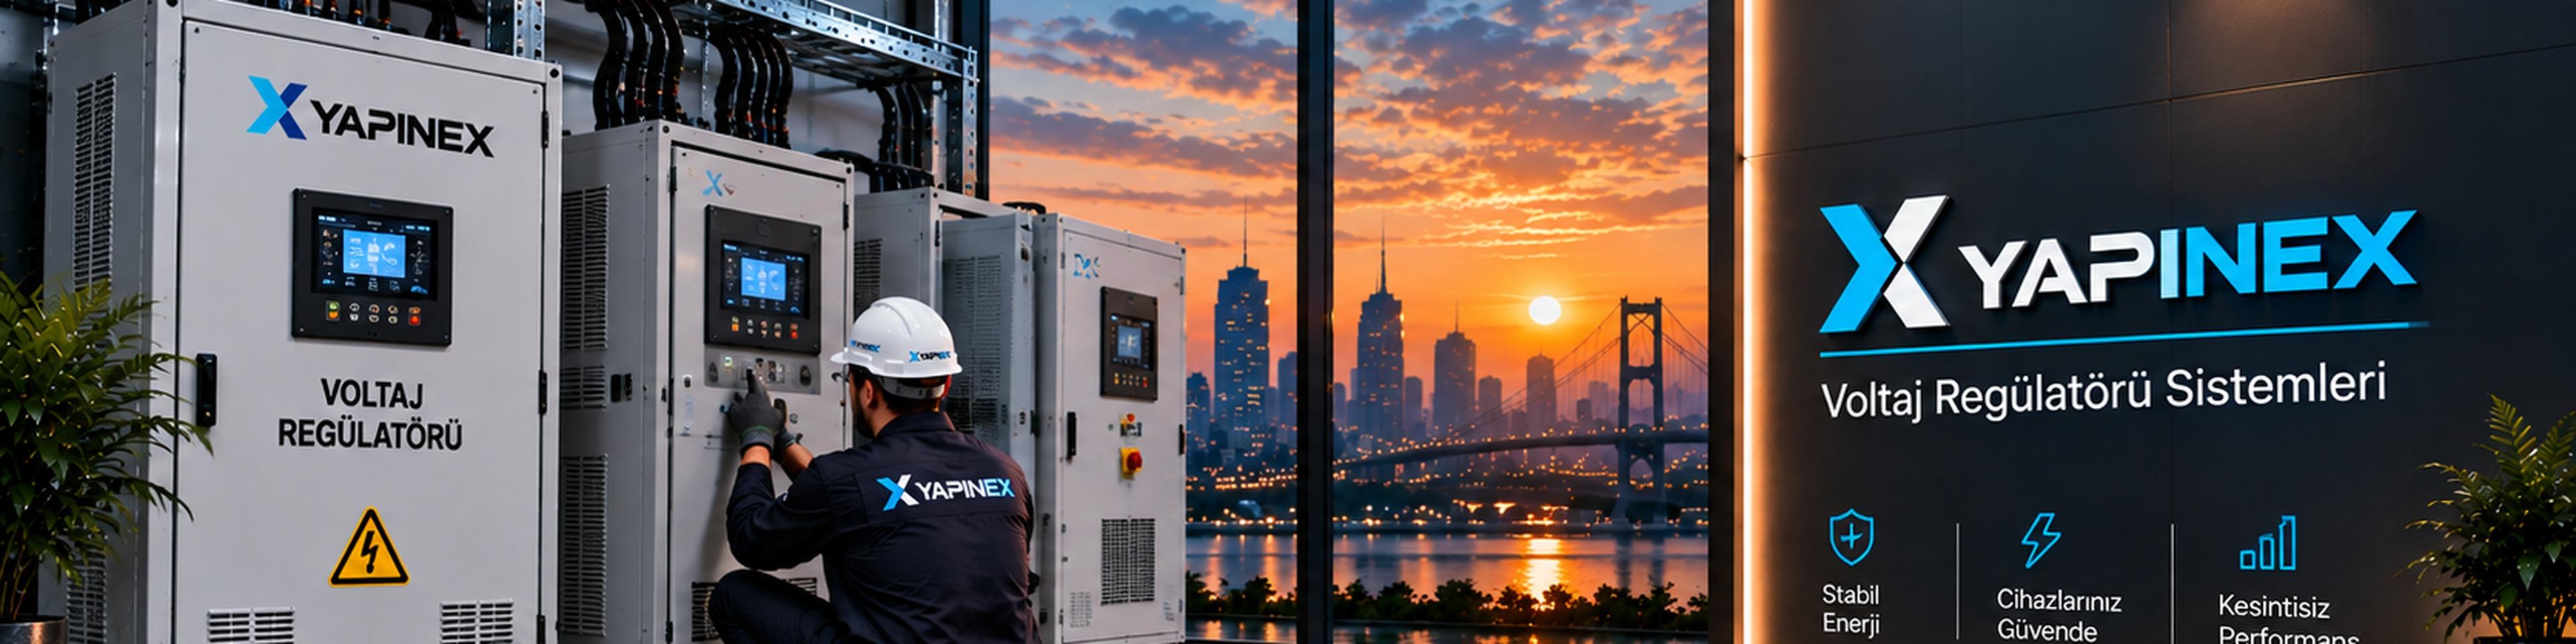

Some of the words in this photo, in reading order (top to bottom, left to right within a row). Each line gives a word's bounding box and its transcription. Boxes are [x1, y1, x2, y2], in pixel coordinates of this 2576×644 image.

[310, 99, 495, 158] YAPINEX
[1957, 209, 2418, 309] YAPINEX
[321, 378, 423, 409] VOLTAJ
[1821, 380, 1922, 425] Voltaj
[1936, 371, 2151, 423] Regülatörü
[2166, 360, 2386, 407] Sistemleri
[278, 414, 463, 451] REGÜLATÖRÜ
[914, 478, 1016, 501] YAPINEX
[1823, 584, 1879, 604] Stabil
[1997, 588, 2122, 612] Cihazlarınız
[2219, 594, 2330, 619] Kesintisiz
[1823, 612, 1880, 639] Enerji
[1998, 618, 2098, 643] Güvende
